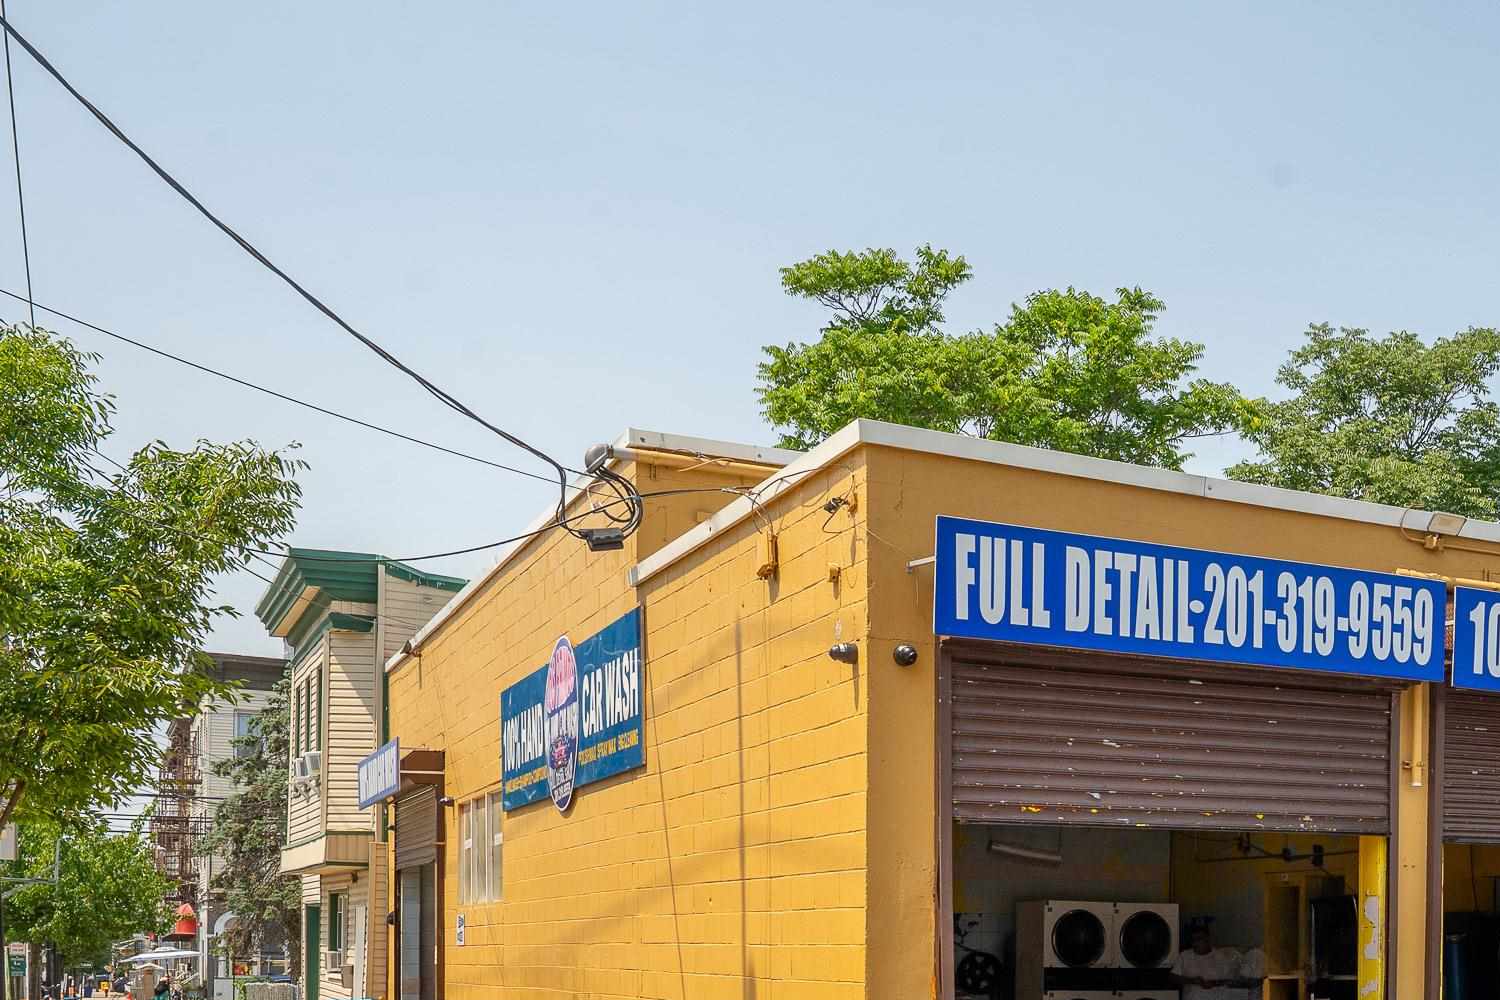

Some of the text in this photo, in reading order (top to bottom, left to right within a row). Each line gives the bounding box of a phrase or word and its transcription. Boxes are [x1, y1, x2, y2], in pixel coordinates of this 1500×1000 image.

[955, 532, 1434, 666] FULL DETAIL 201-319-9559
[521, 703, 543, 763] HAND
[582, 668, 603, 738] CAR
[604, 648, 639, 728] WASH
